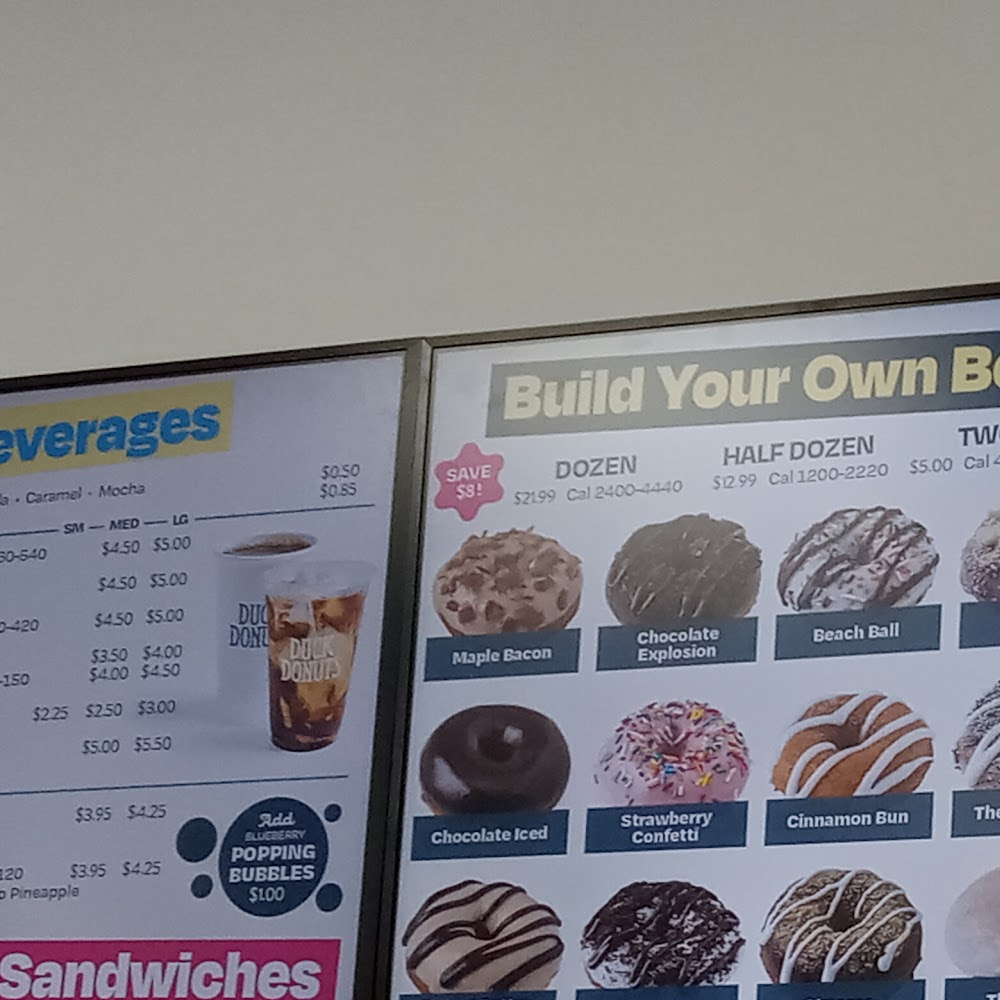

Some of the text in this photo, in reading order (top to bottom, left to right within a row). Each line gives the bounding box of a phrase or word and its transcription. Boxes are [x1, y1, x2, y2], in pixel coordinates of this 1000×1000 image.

[503, 367, 645, 420] Build
[657, 364, 791, 411] Your
[803, 354, 938, 402] Own
[723, 435, 874, 466] HALF DOZEN
[321, 464, 360, 480] $0.50
[446, 464, 491, 482] SAVE
[555, 455, 638, 480] DOZEN
[797, 463, 889, 483] 1200-2220
[910, 457, 953, 475] $5.00
[964, 454, 990, 471] Cal
[99, 482, 145, 498] Mocha
[595, 480, 683, 499] 2400-4440
[109, 518, 140, 531] MED
[152, 536, 191, 552] $5.00
[150, 572, 188, 588] $5.00
[145, 608, 184, 624] $5.00
[637, 626, 719, 644] Chocolate
[813, 623, 900, 642] Beach Ball
[142, 644, 182, 661] $4.00
[452, 646, 552, 667] Maple Bacon
[638, 645, 717, 664] Explosion
[82, 739, 120, 756] $5.00
[258, 811, 296, 828] Add
[620, 811, 713, 829] Strawberry
[787, 810, 909, 829] Cinnamon Bun
[431, 825, 548, 845] Chocolate Iced
[632, 827, 700, 844] Confetti
[231, 844, 316, 862] POPPING
[229, 865, 315, 883] BUBBLES
[10, 884, 79, 901] Pineapple
[0, 951, 322, 1000] Sandwiches
